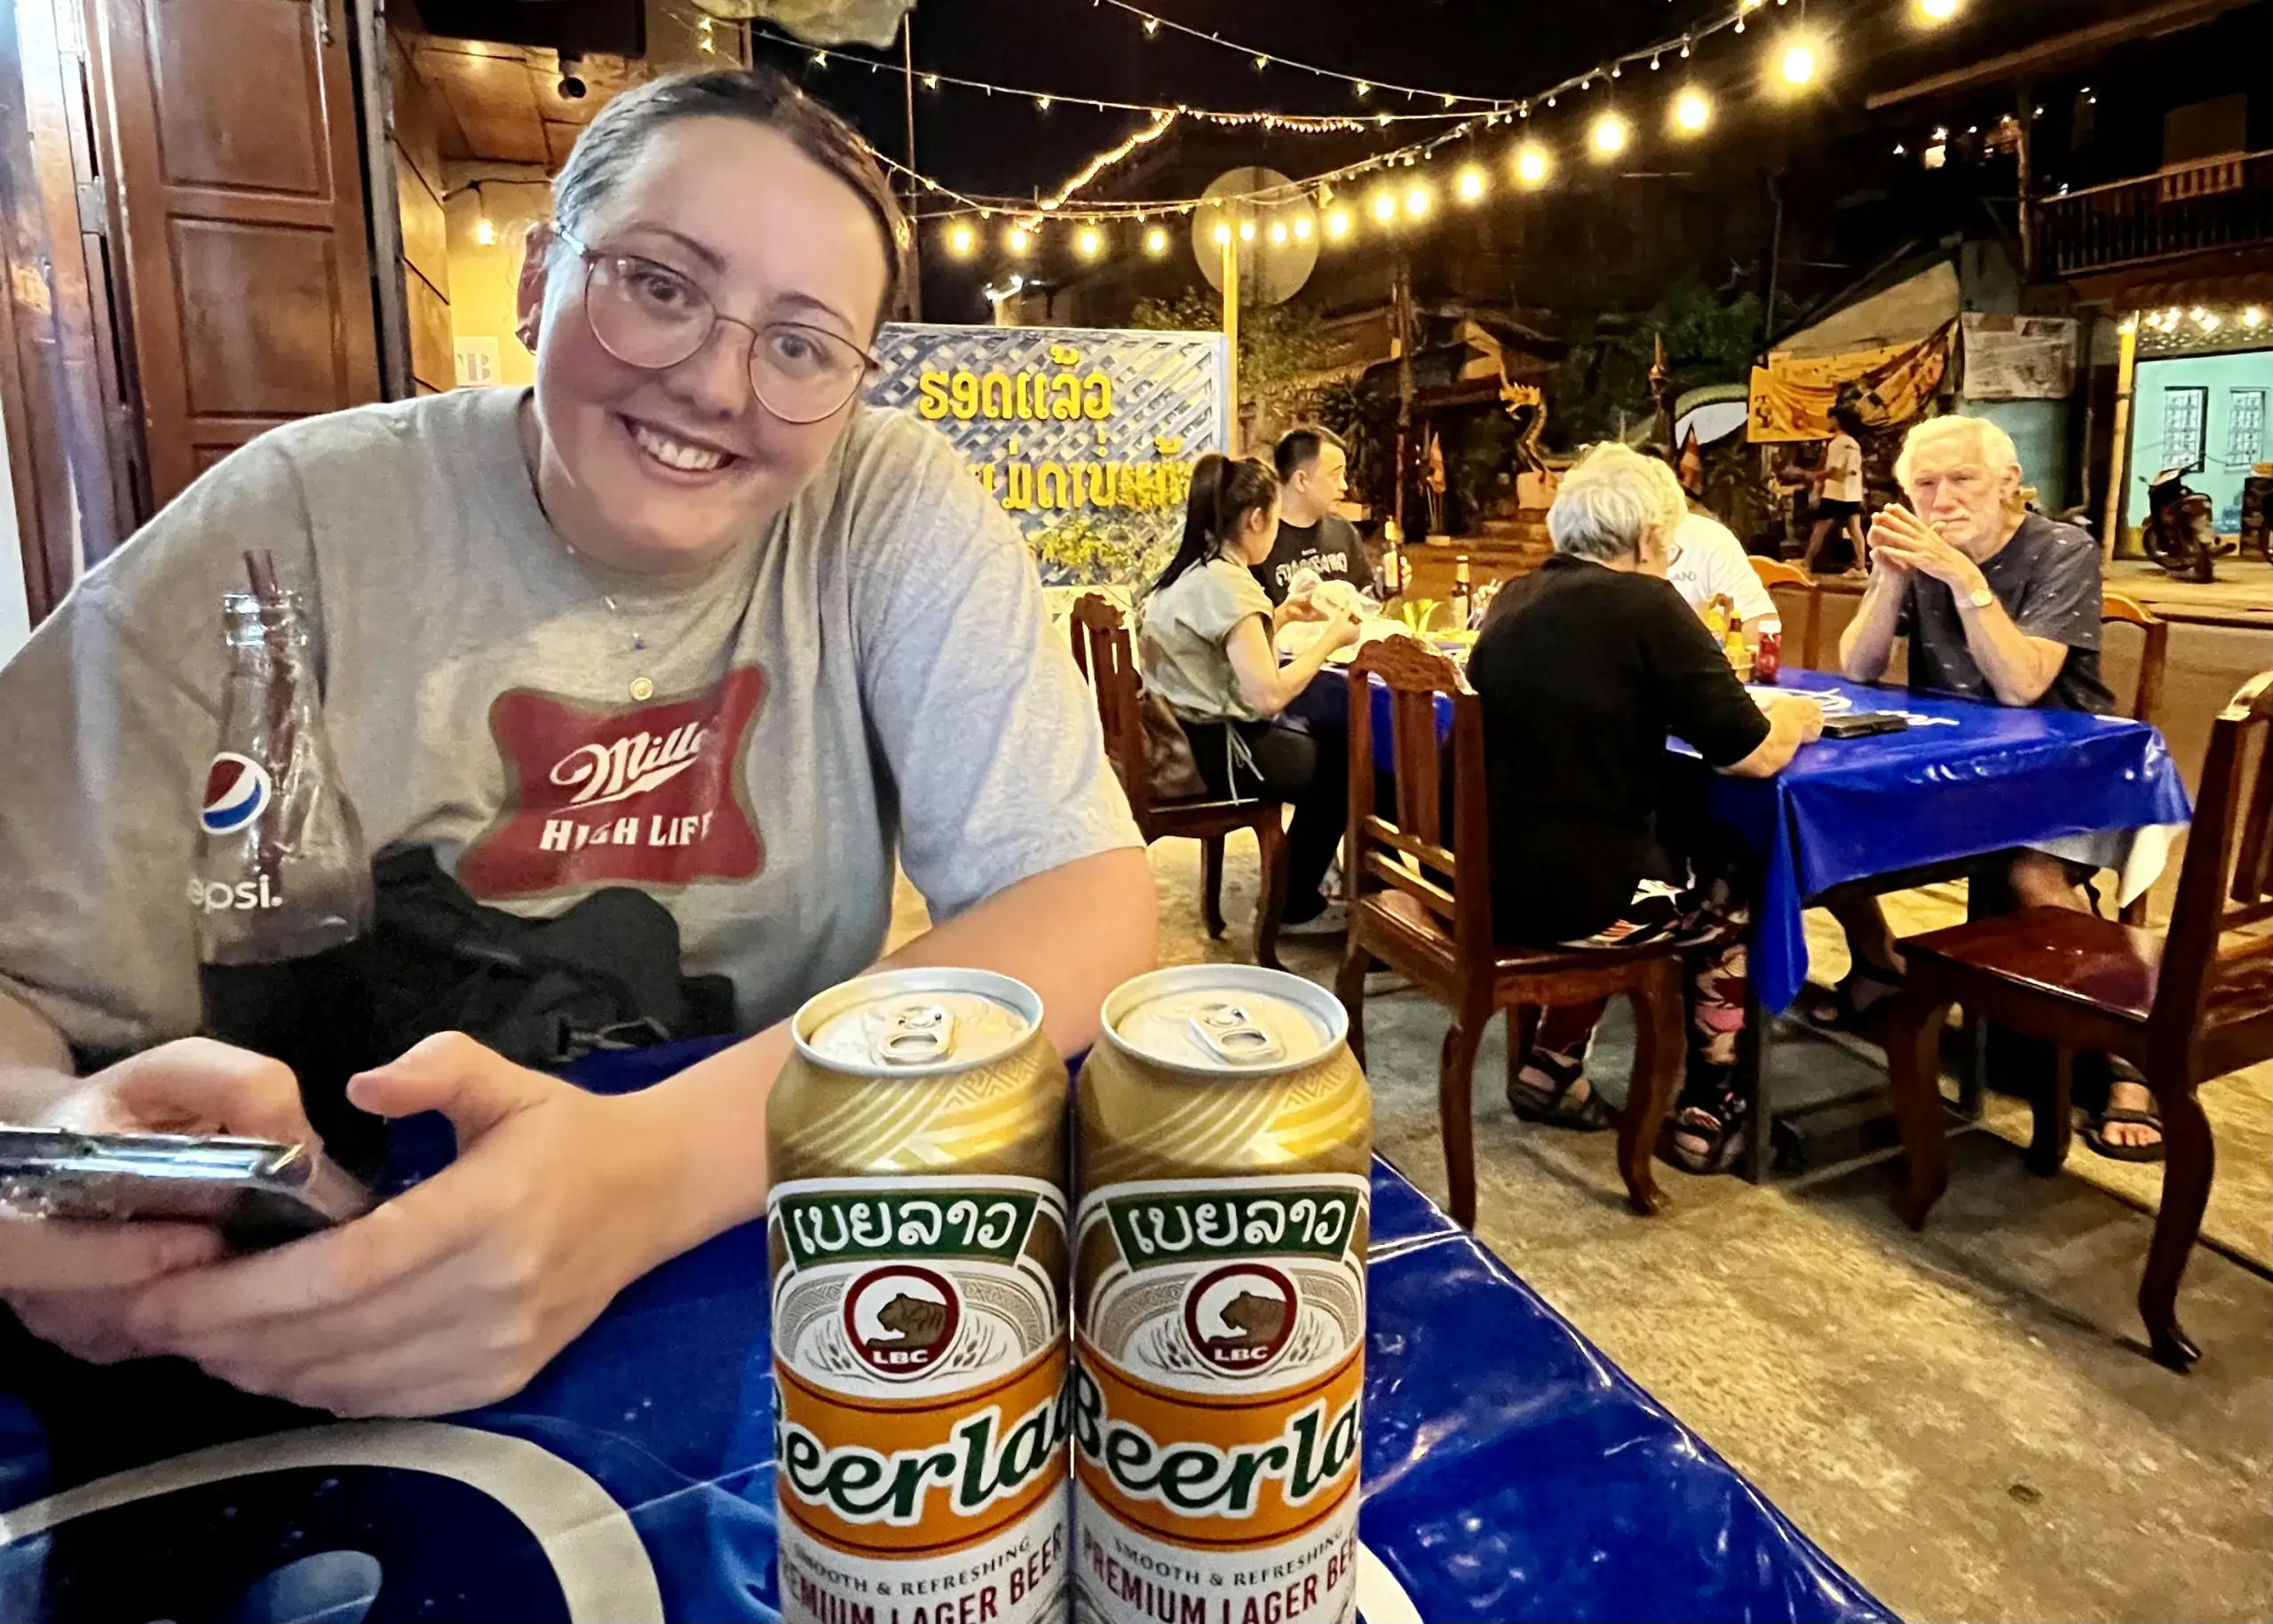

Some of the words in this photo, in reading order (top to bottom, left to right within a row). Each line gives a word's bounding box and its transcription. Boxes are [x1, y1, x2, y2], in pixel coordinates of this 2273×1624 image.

[549, 721, 709, 804] Mill
[539, 817, 639, 852] HIGH
[793, 1199, 1018, 1255] ເບຍລາວ
[1128, 1199, 1347, 1255] ເບຍລາວ
[872, 1349, 929, 1365] LBC
[1214, 1345, 1269, 1362] LBC
[773, 1382, 1066, 1517] eerla
[1070, 1363, 1360, 1510] Beerla
[877, 1581, 891, 1596] &
[901, 1535, 1030, 1596] REFRESHING
[1010, 1522, 1063, 1605] BEER
[1114, 1537, 1200, 1586] SMOOTH
[1209, 1573, 1224, 1587] &
[1233, 1524, 1343, 1587] REFRESHING
